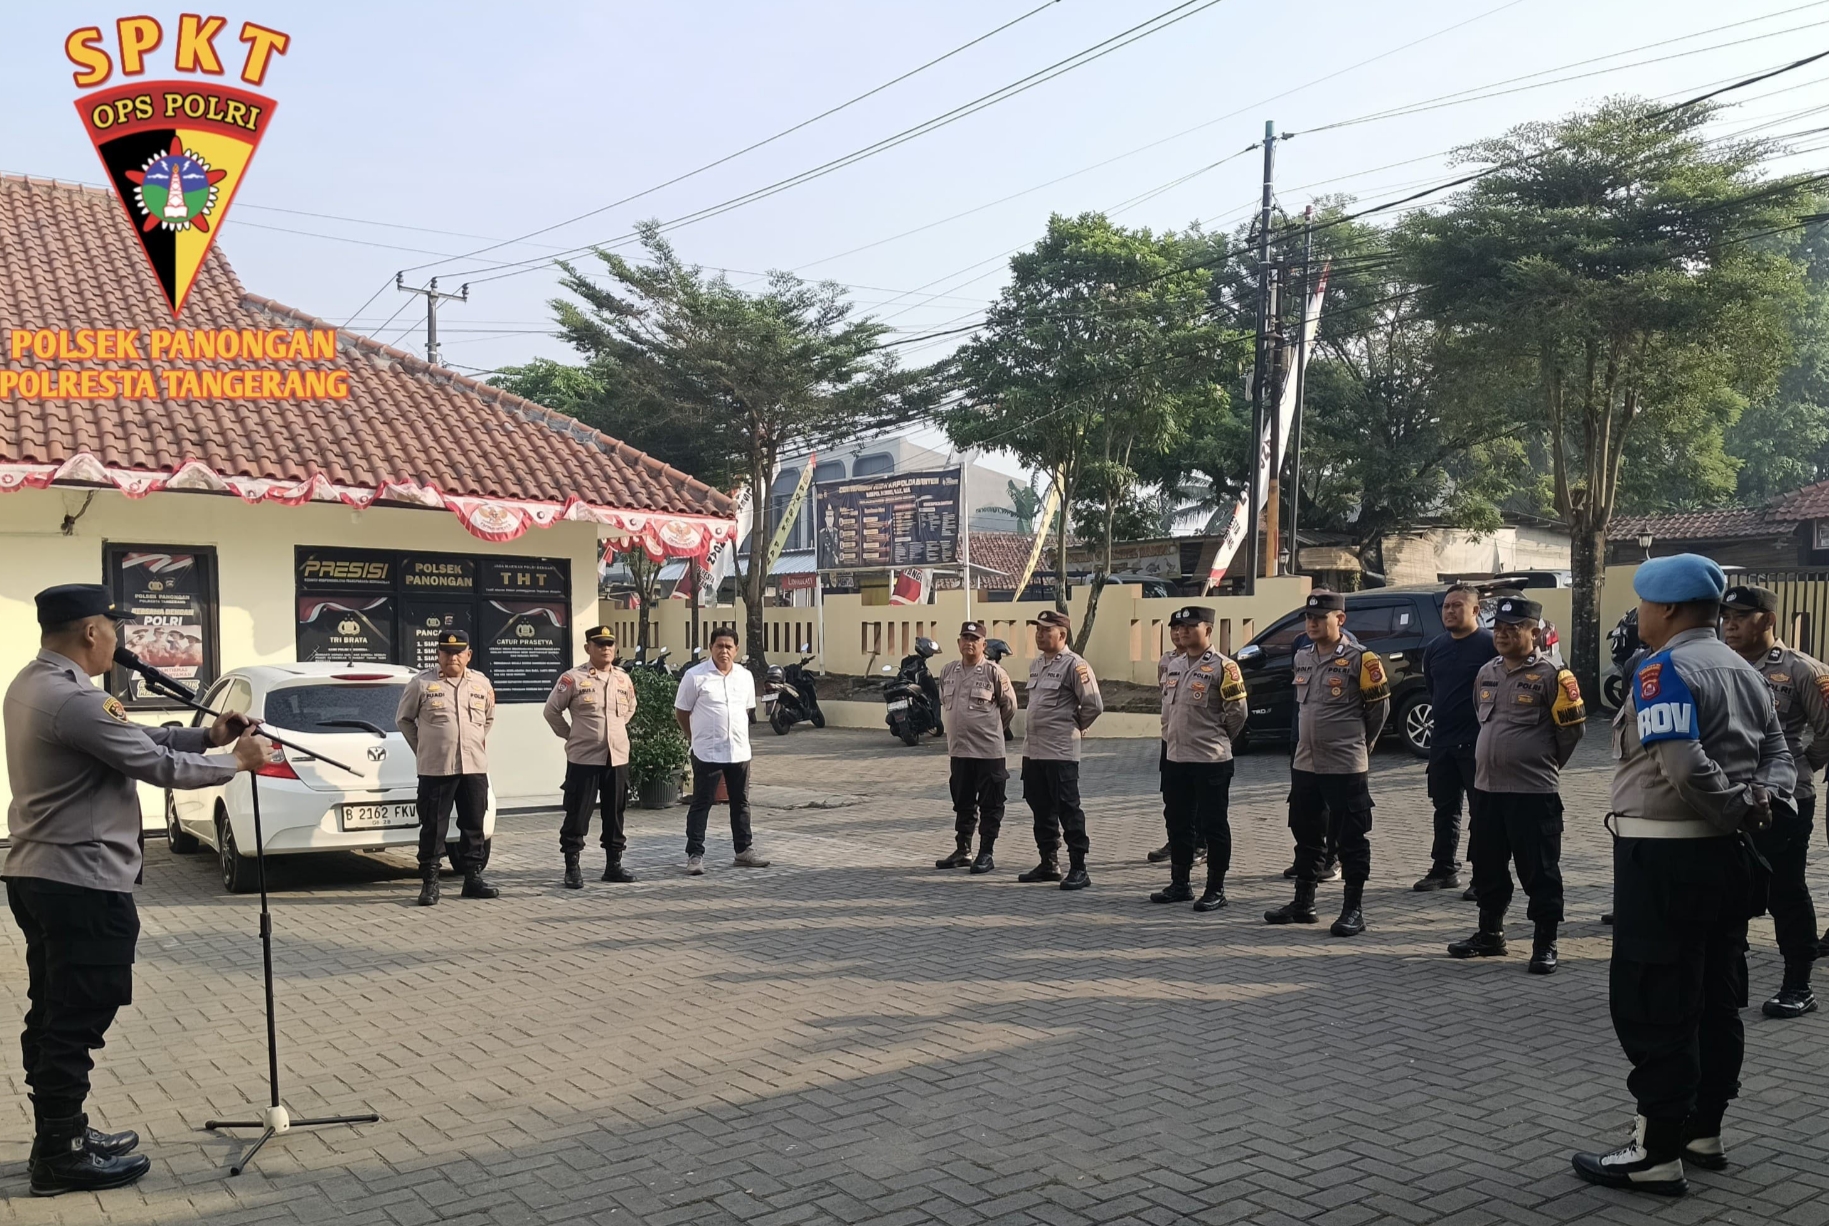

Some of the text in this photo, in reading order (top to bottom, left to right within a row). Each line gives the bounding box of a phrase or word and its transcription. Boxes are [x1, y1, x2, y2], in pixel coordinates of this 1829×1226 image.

[304, 560, 389, 579] PRESISI
[415, 562, 462, 574] POLSEK
[405, 574, 473, 587] PANONGAN
[143, 615, 183, 626] POLRI
[1193, 672, 1211, 680] POLRI
[1517, 681, 1541, 691] POLRI
[345, 805, 416, 821] B 2162 FKV
